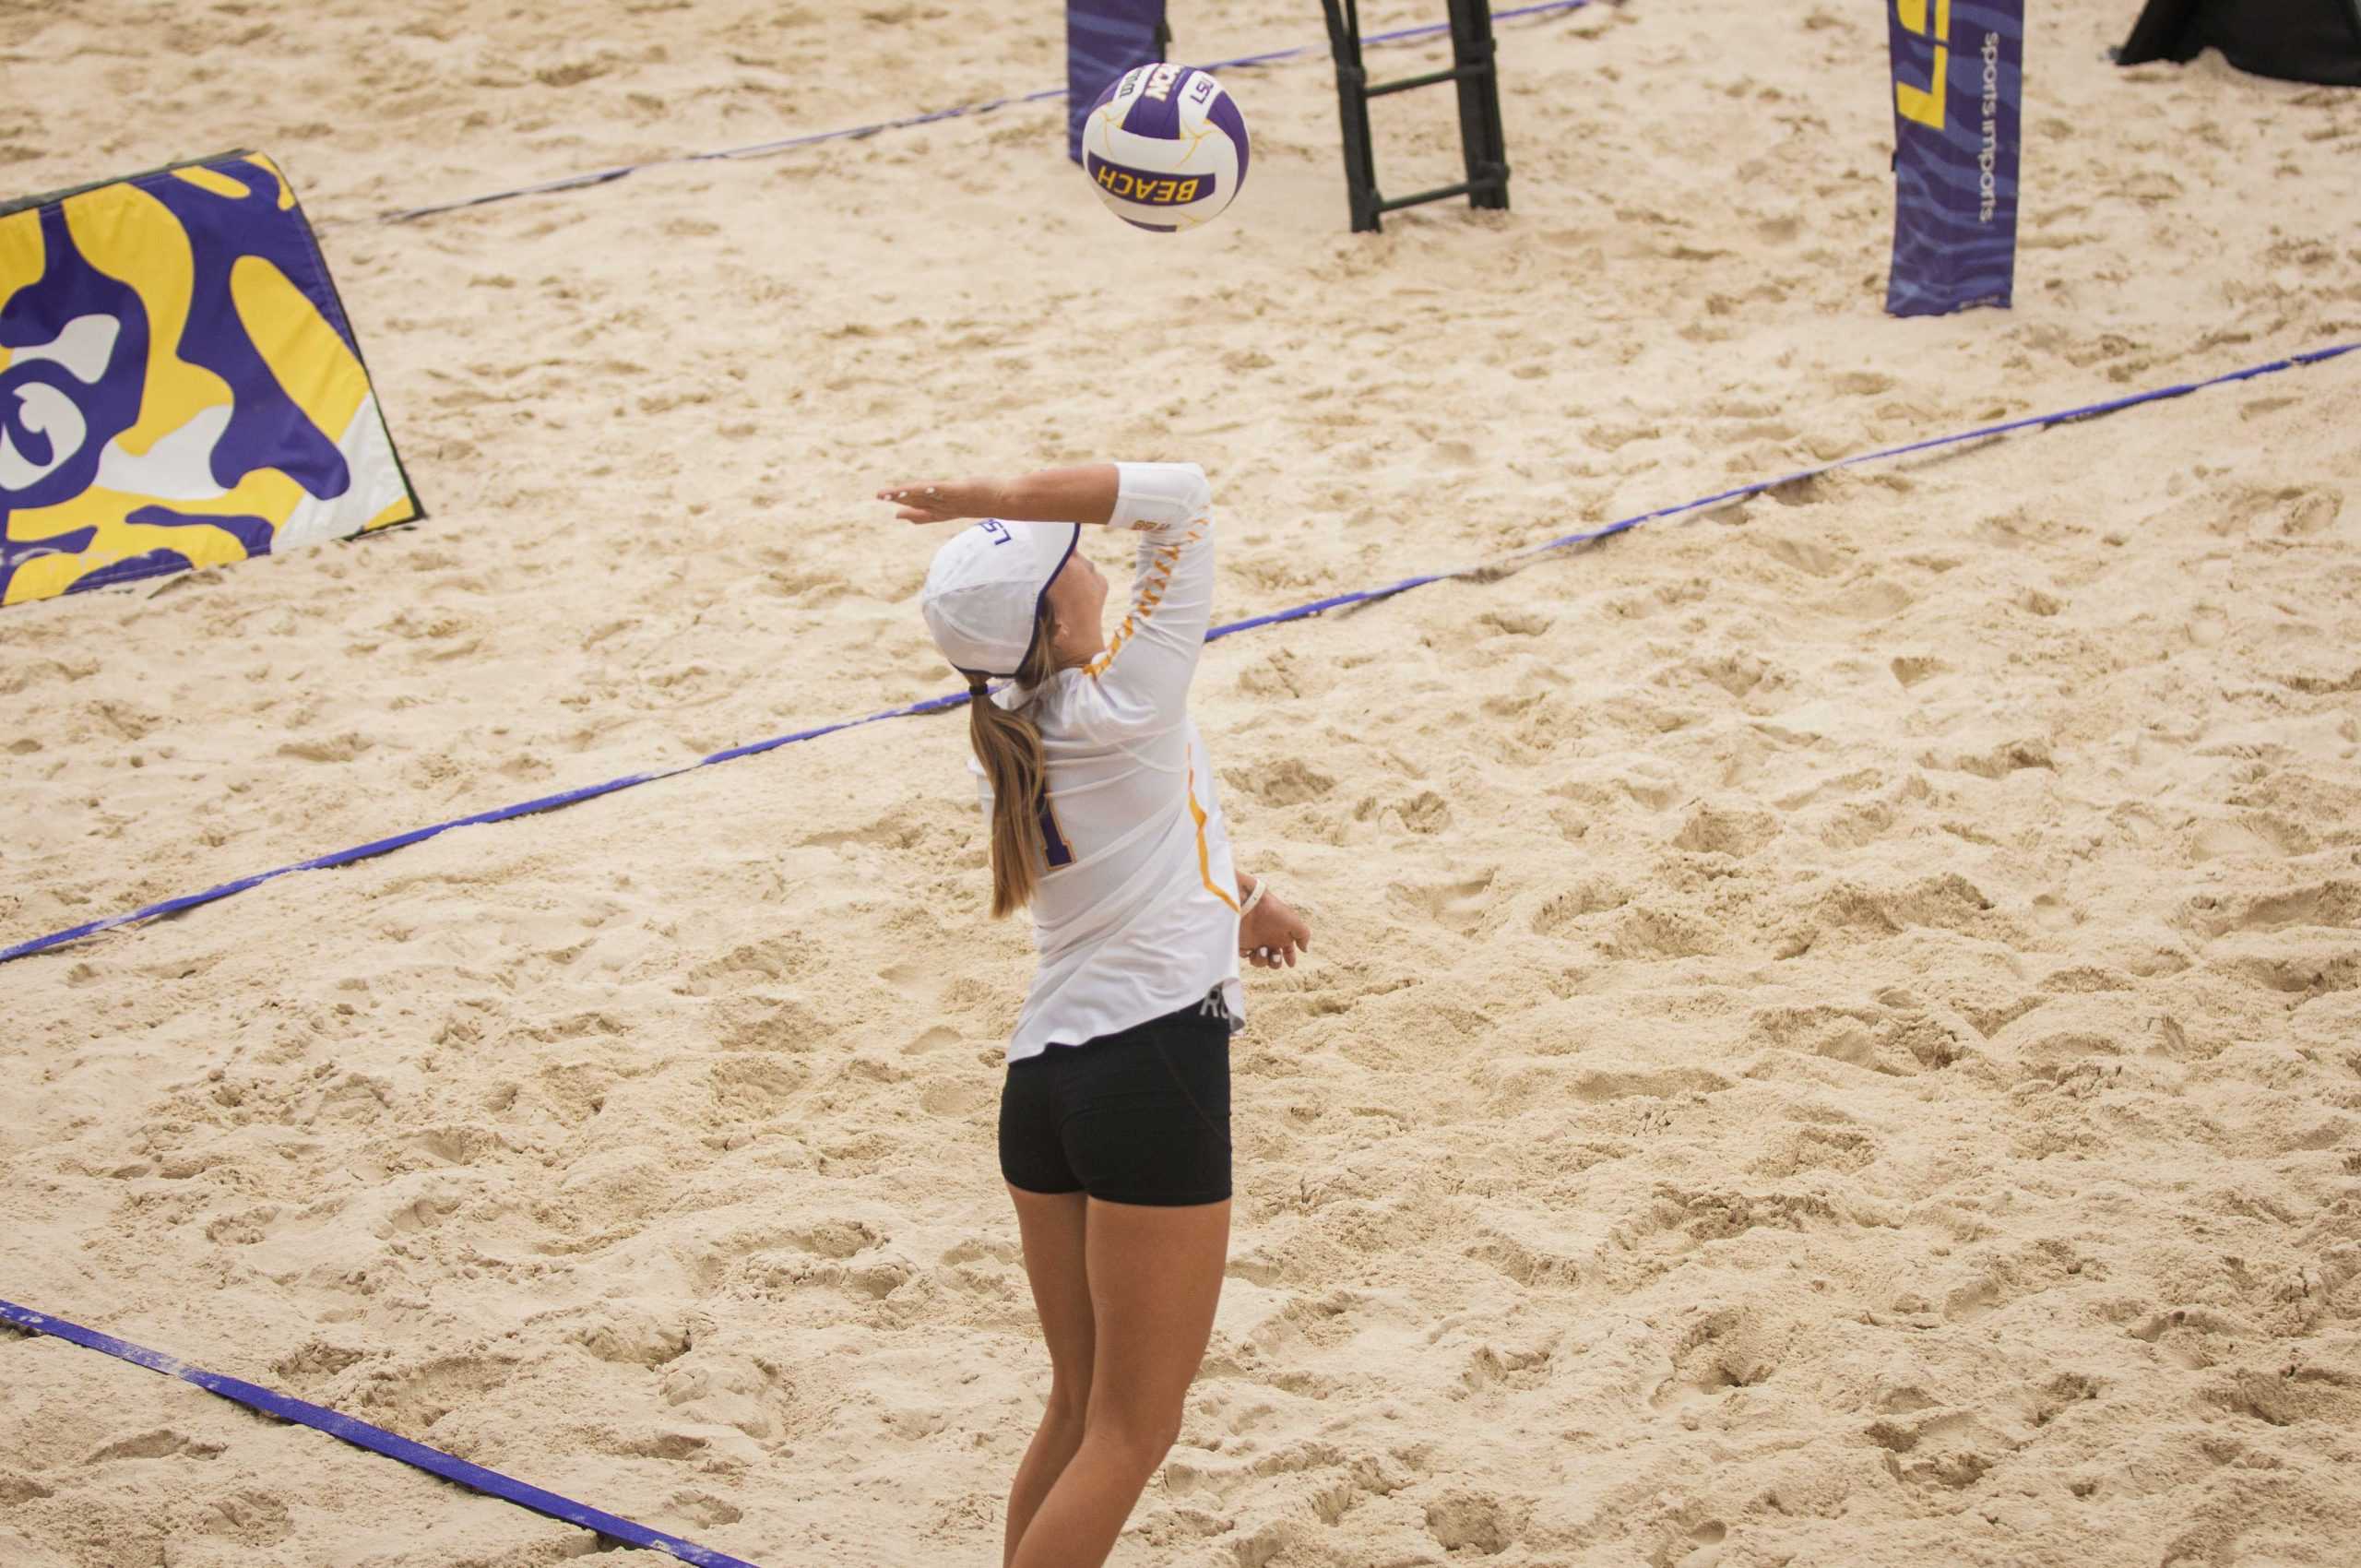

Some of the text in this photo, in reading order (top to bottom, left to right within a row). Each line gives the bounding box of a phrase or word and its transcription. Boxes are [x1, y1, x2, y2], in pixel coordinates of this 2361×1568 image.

[1097, 165, 1200, 202] BEACH
[1977, 31, 1999, 223] sports imports
